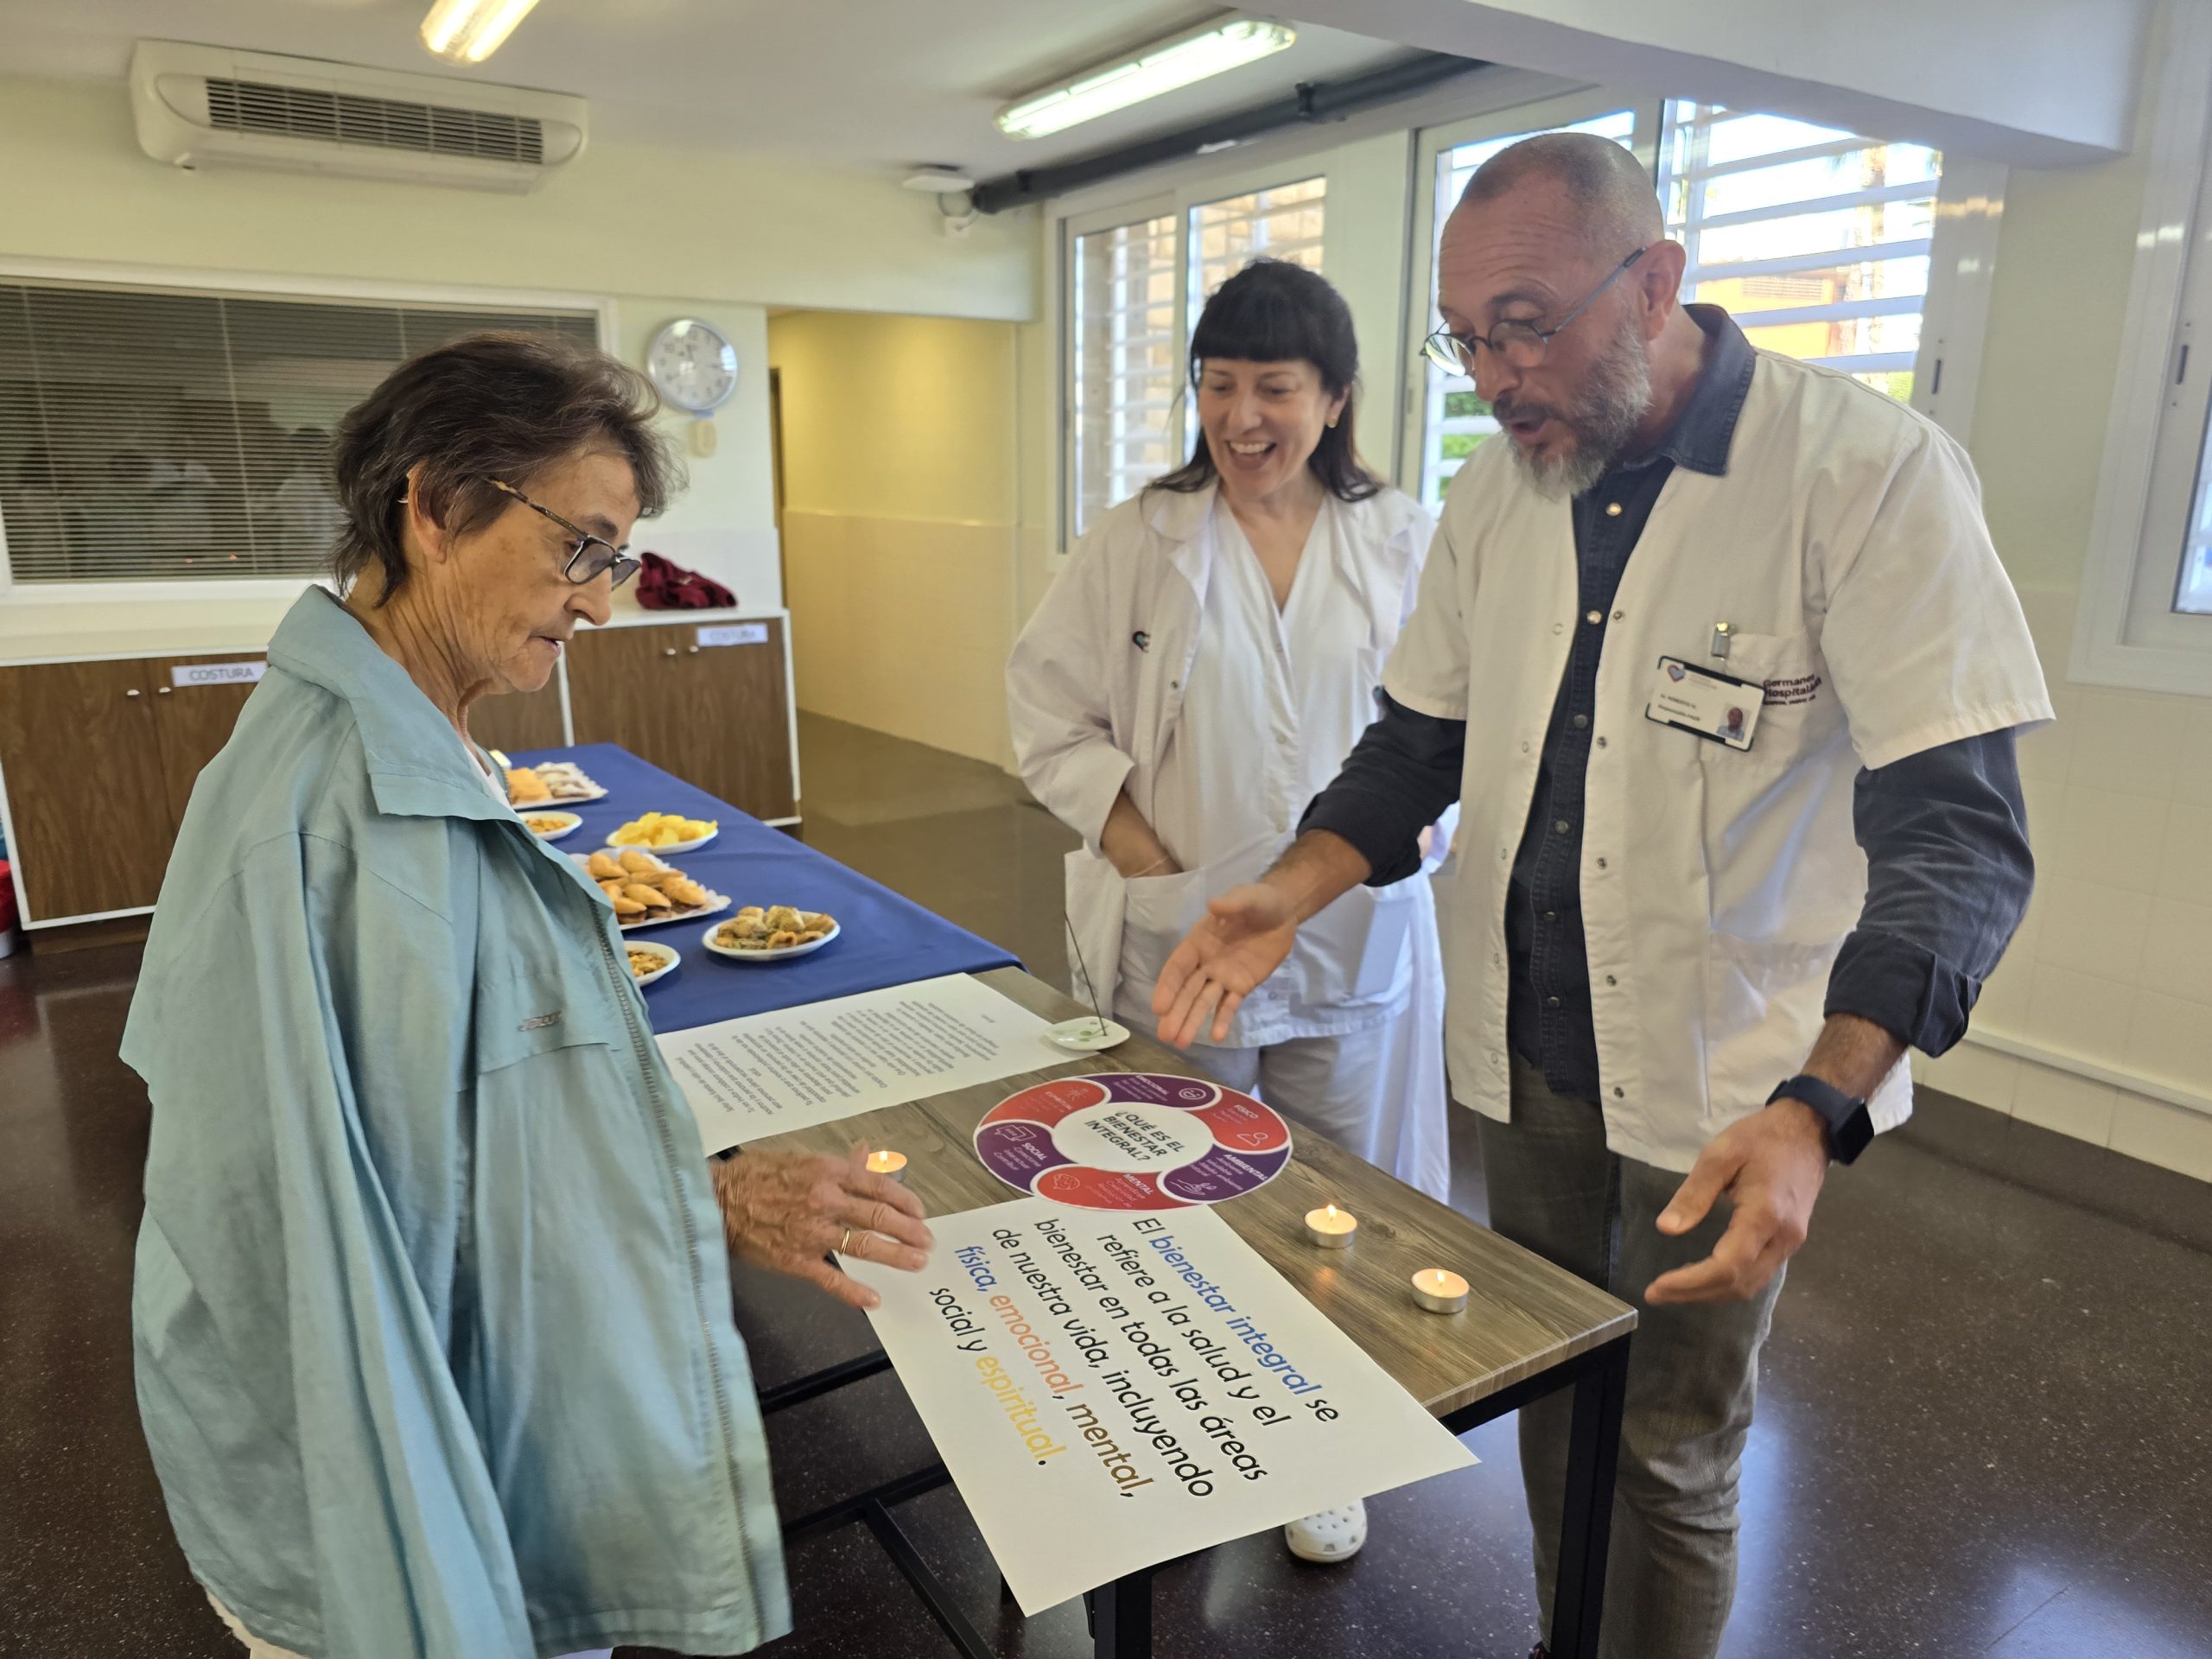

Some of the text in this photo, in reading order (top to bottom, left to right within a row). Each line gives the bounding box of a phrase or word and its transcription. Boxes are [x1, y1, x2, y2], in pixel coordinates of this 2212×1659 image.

[189, 667, 255, 681] COSTURA
[1021, 1142, 1048, 1160] SOCIAL
[1084, 1120, 1151, 1160] INTEGRAL?
[1103, 1116, 1167, 1156] BIENESTAR
[1115, 1111, 1185, 1152] ¿QUÉ ES EL
[1122, 1173, 1154, 1195] MENTAL
[1223, 1154, 1268, 1181] AMBIENTAL
[1096, 1234, 1155, 1287] refiere
[1147, 1291, 1171, 1304] a
[1160, 1305, 1192, 1326] la
[1180, 1329, 1253, 1382] salud
[1226, 1385, 1261, 1400] y
[1252, 1405, 1293, 1427] el
[1132, 1217, 1338, 1422] El bienestar integral se
[992, 1228, 1214, 1497] de nuestra vida, incluyendo
[1033, 1218, 1109, 1292] bienestar
[1098, 1296, 1130, 1319] en
[1120, 1321, 1180, 1377] todas
[1168, 1377, 1209, 1411] las
[1199, 1415, 1268, 1480] áreas
[928, 1287, 1067, 1467] social y espiritual.
[954, 1245, 1155, 1498] física, emocional, mental,
